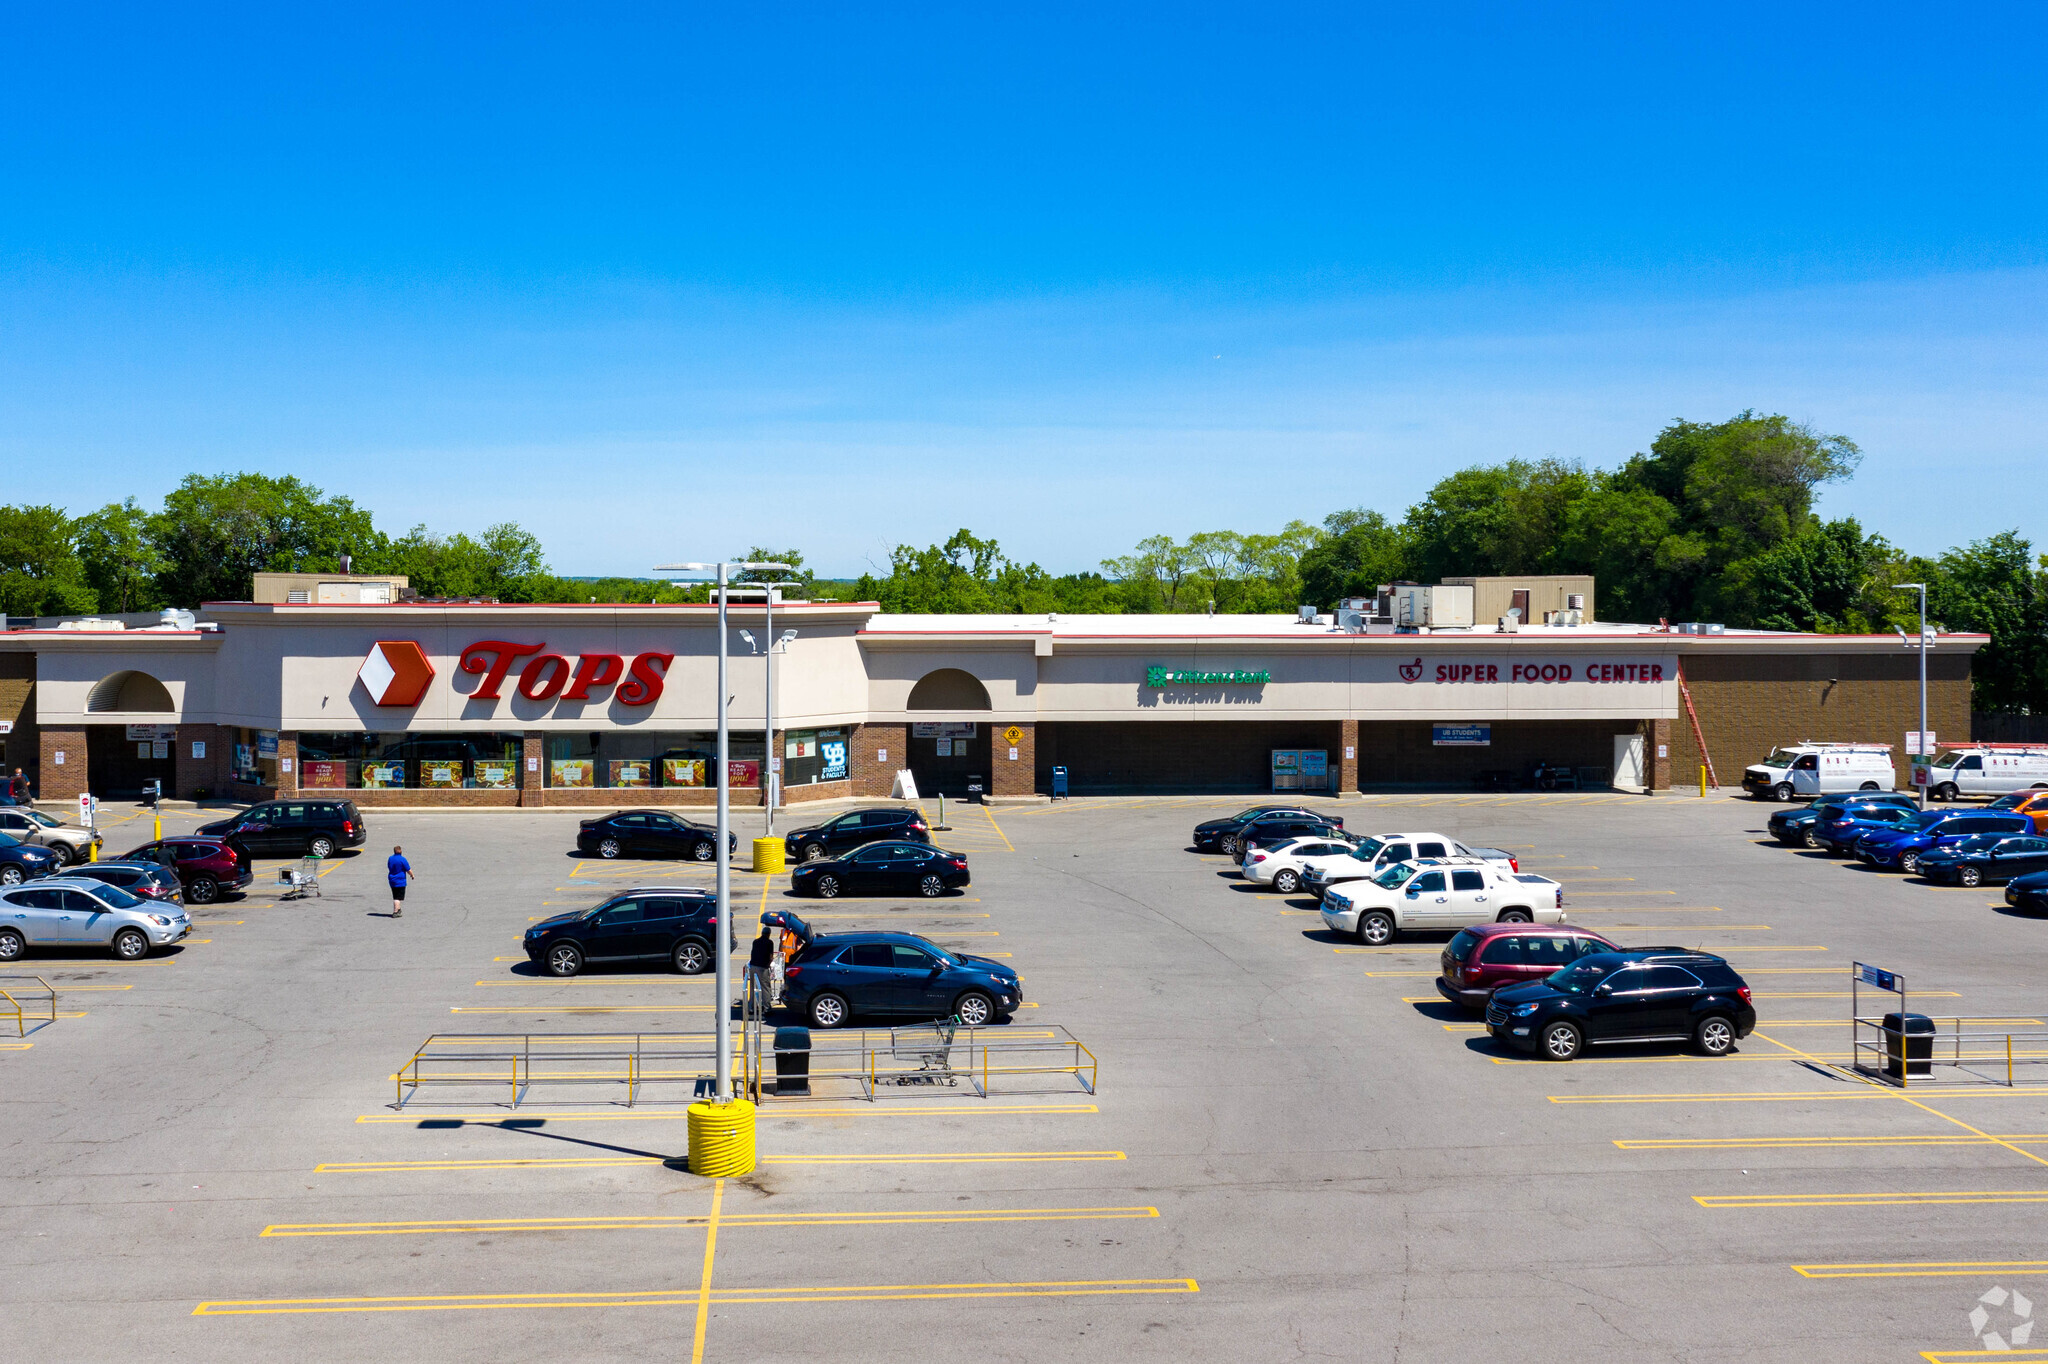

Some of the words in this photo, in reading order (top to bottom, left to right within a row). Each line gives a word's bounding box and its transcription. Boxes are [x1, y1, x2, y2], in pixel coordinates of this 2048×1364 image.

[460, 640, 675, 706] TOPS
[1173, 669, 1232, 684] Citizens
[1235, 669, 1272, 684] Bank
[1436, 664, 1498, 682] SUPER
[1512, 664, 1572, 682] FOOD
[1586, 664, 1663, 682] CENTER
[821, 741, 847, 768] UB
[822, 765, 846, 773] STUDENTS
[826, 770, 847, 779] FACULTY
[315, 773, 336, 785] you!
[729, 773, 750, 784] you!
